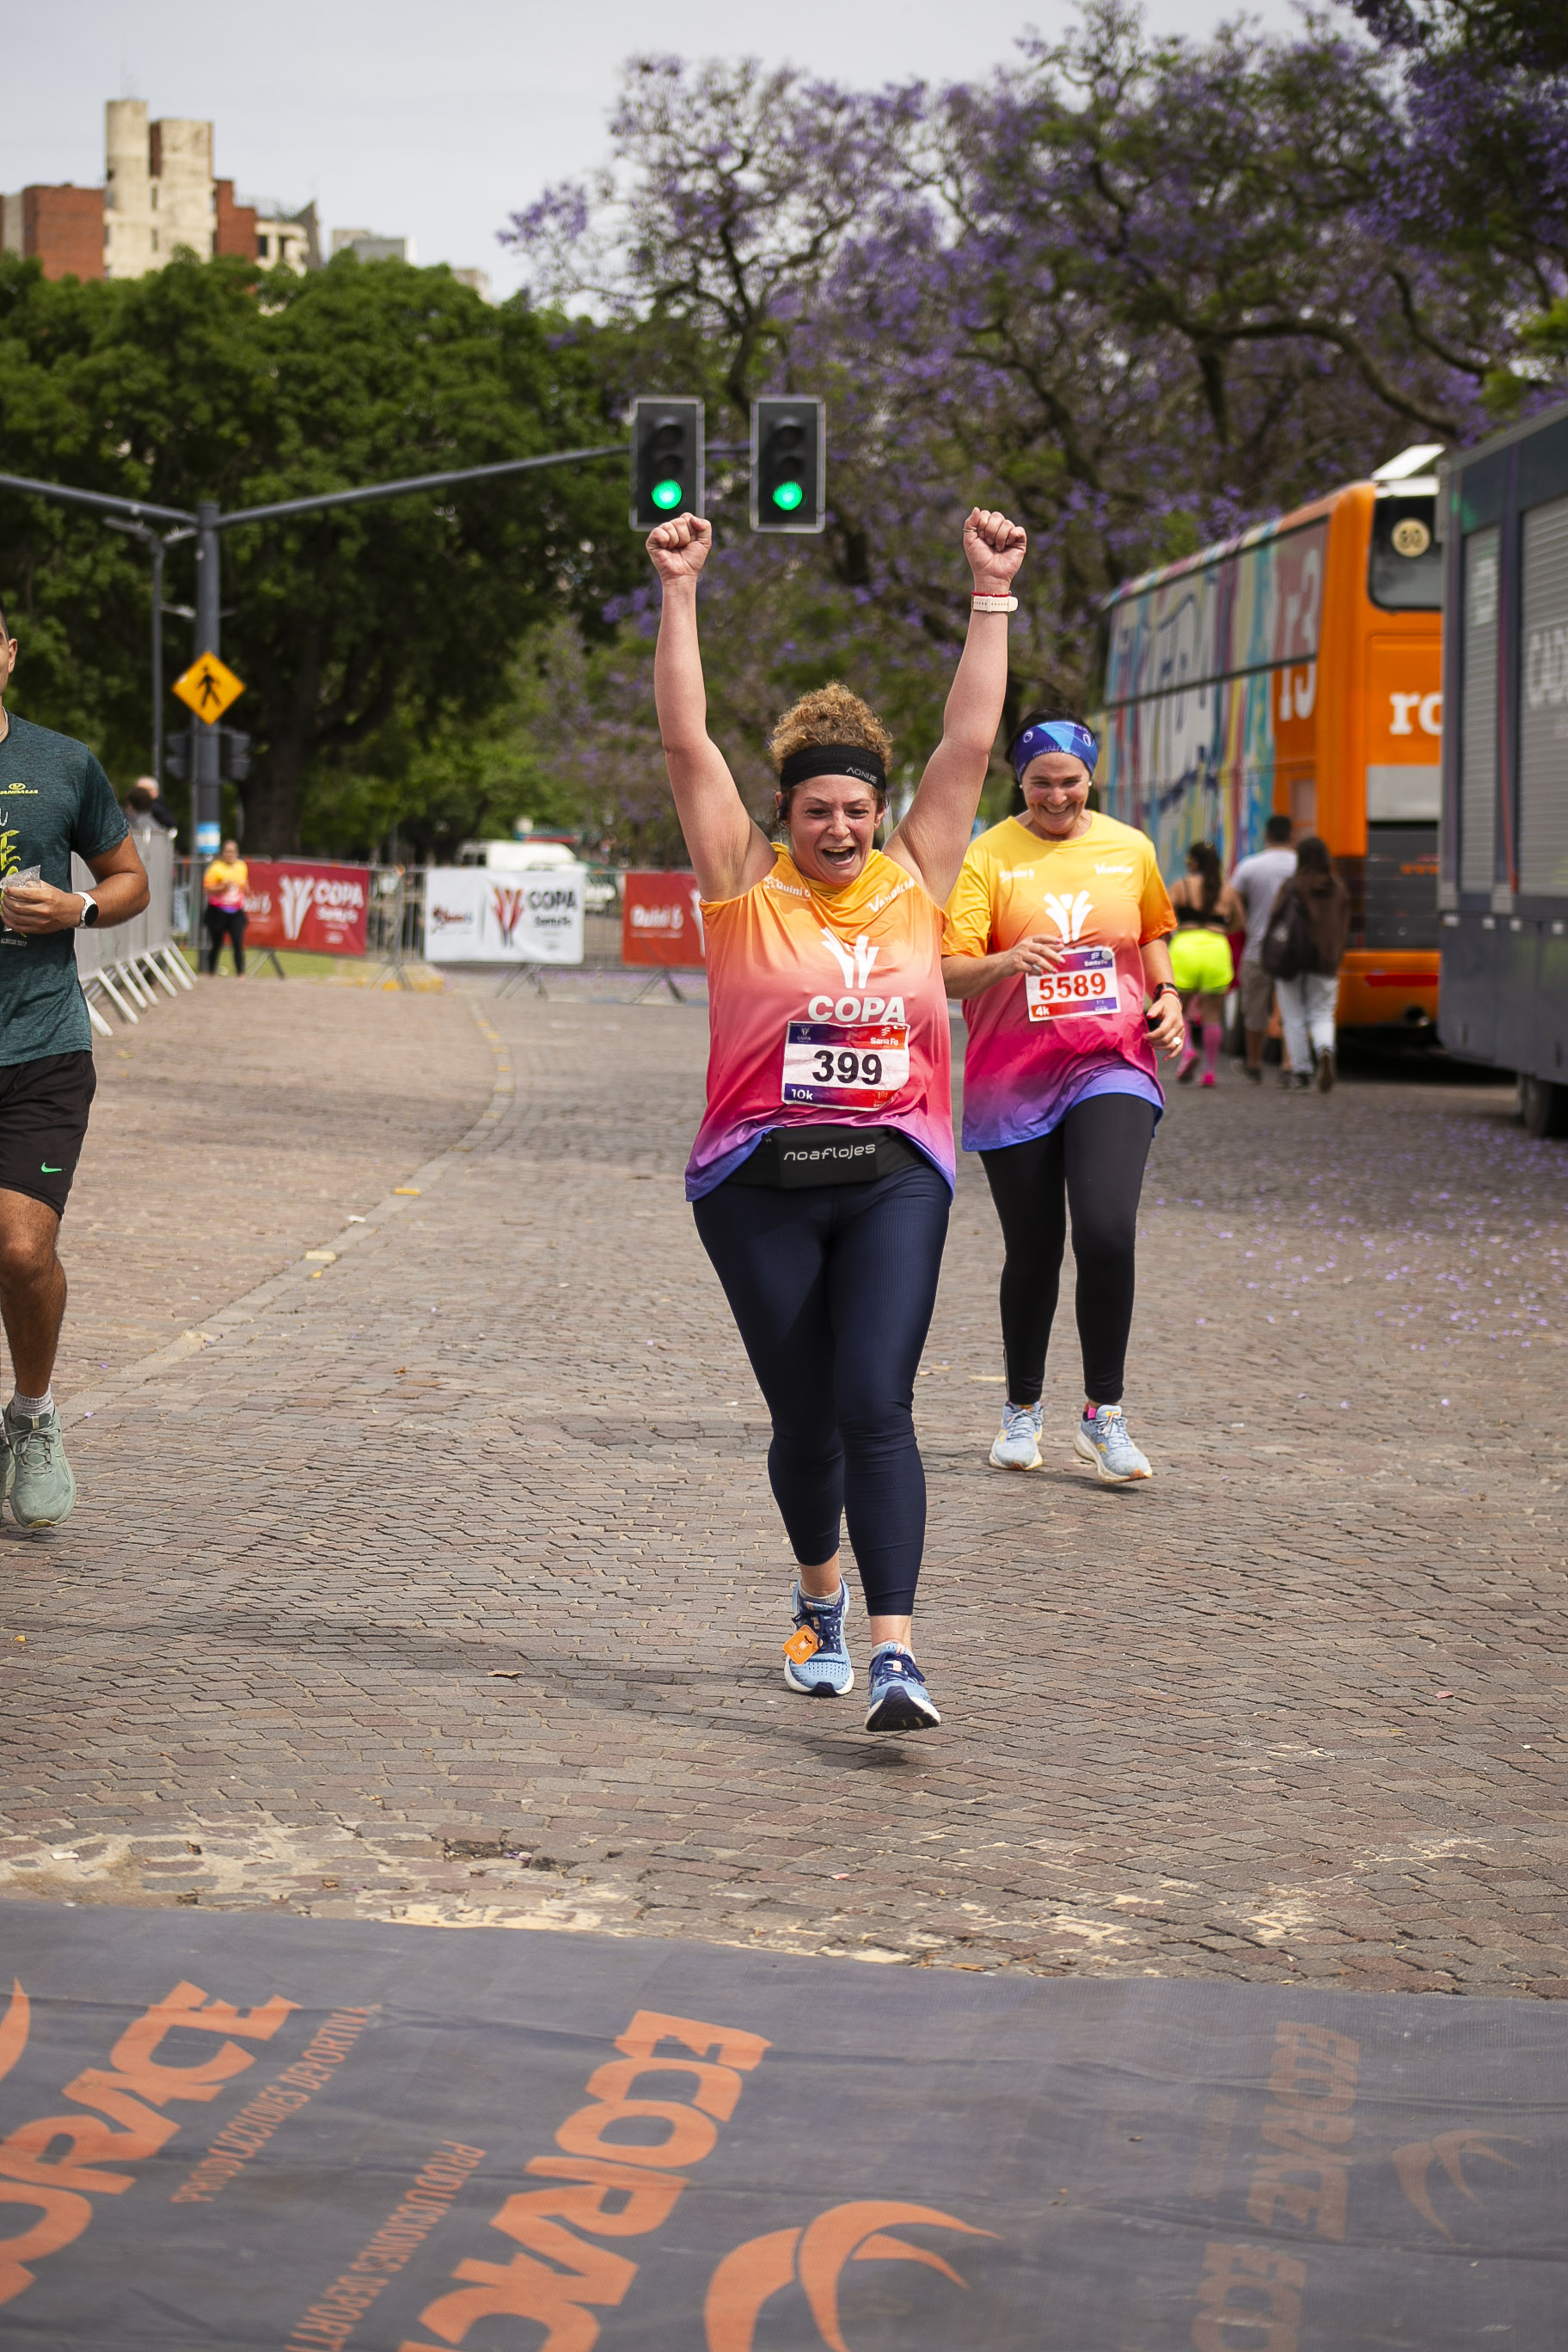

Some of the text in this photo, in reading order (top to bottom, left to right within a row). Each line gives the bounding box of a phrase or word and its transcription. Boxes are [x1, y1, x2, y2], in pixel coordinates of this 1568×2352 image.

[314, 879, 364, 909] COPA
[529, 891, 576, 910] COPA
[1039, 972, 1106, 1001] 5589
[808, 995, 906, 1023] COPA
[1035, 1005, 1050, 1016] 4k
[812, 1050, 883, 1086] 399
[791, 1088, 813, 1100] 10k
[784, 1142, 876, 1161] noaflojes
[398, 2009, 773, 2352] ECORAC
